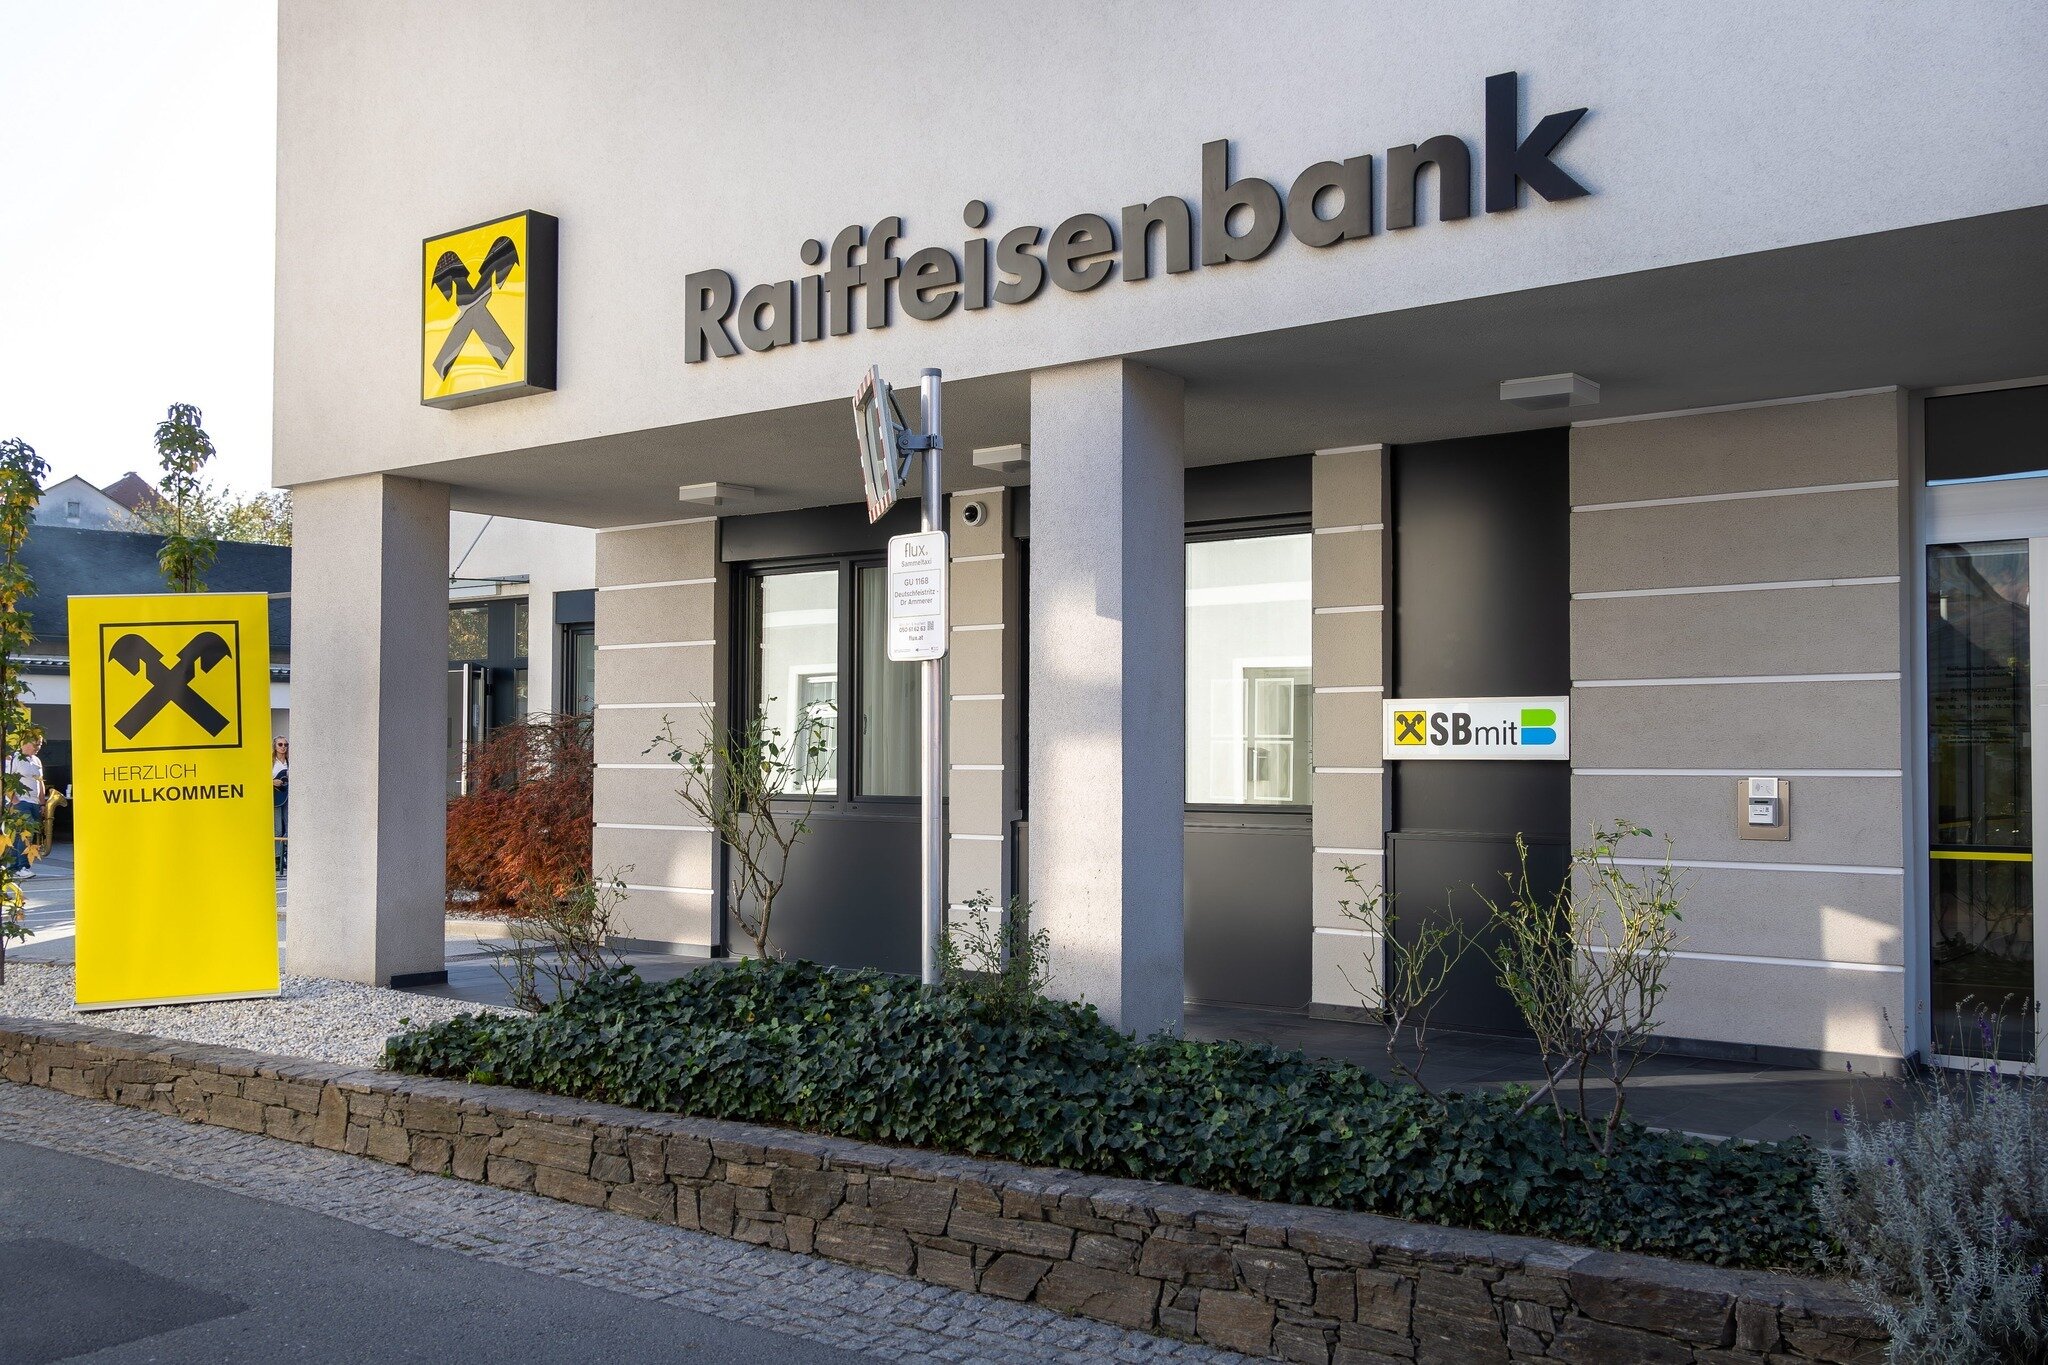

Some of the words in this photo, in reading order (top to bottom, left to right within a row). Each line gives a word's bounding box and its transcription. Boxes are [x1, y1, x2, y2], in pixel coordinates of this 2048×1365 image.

[685, 70, 1592, 363] Raiffeisenbank
[901, 558, 932, 568] Sammeltaxi
[904, 578, 914, 586] GU
[915, 576, 929, 585] 1168
[894, 588, 936, 598] Deutschfeistritz
[907, 598, 933, 606] Ammerer
[103, 763, 197, 781] HERZLICH
[103, 783, 244, 804] WILLKOMMEN
